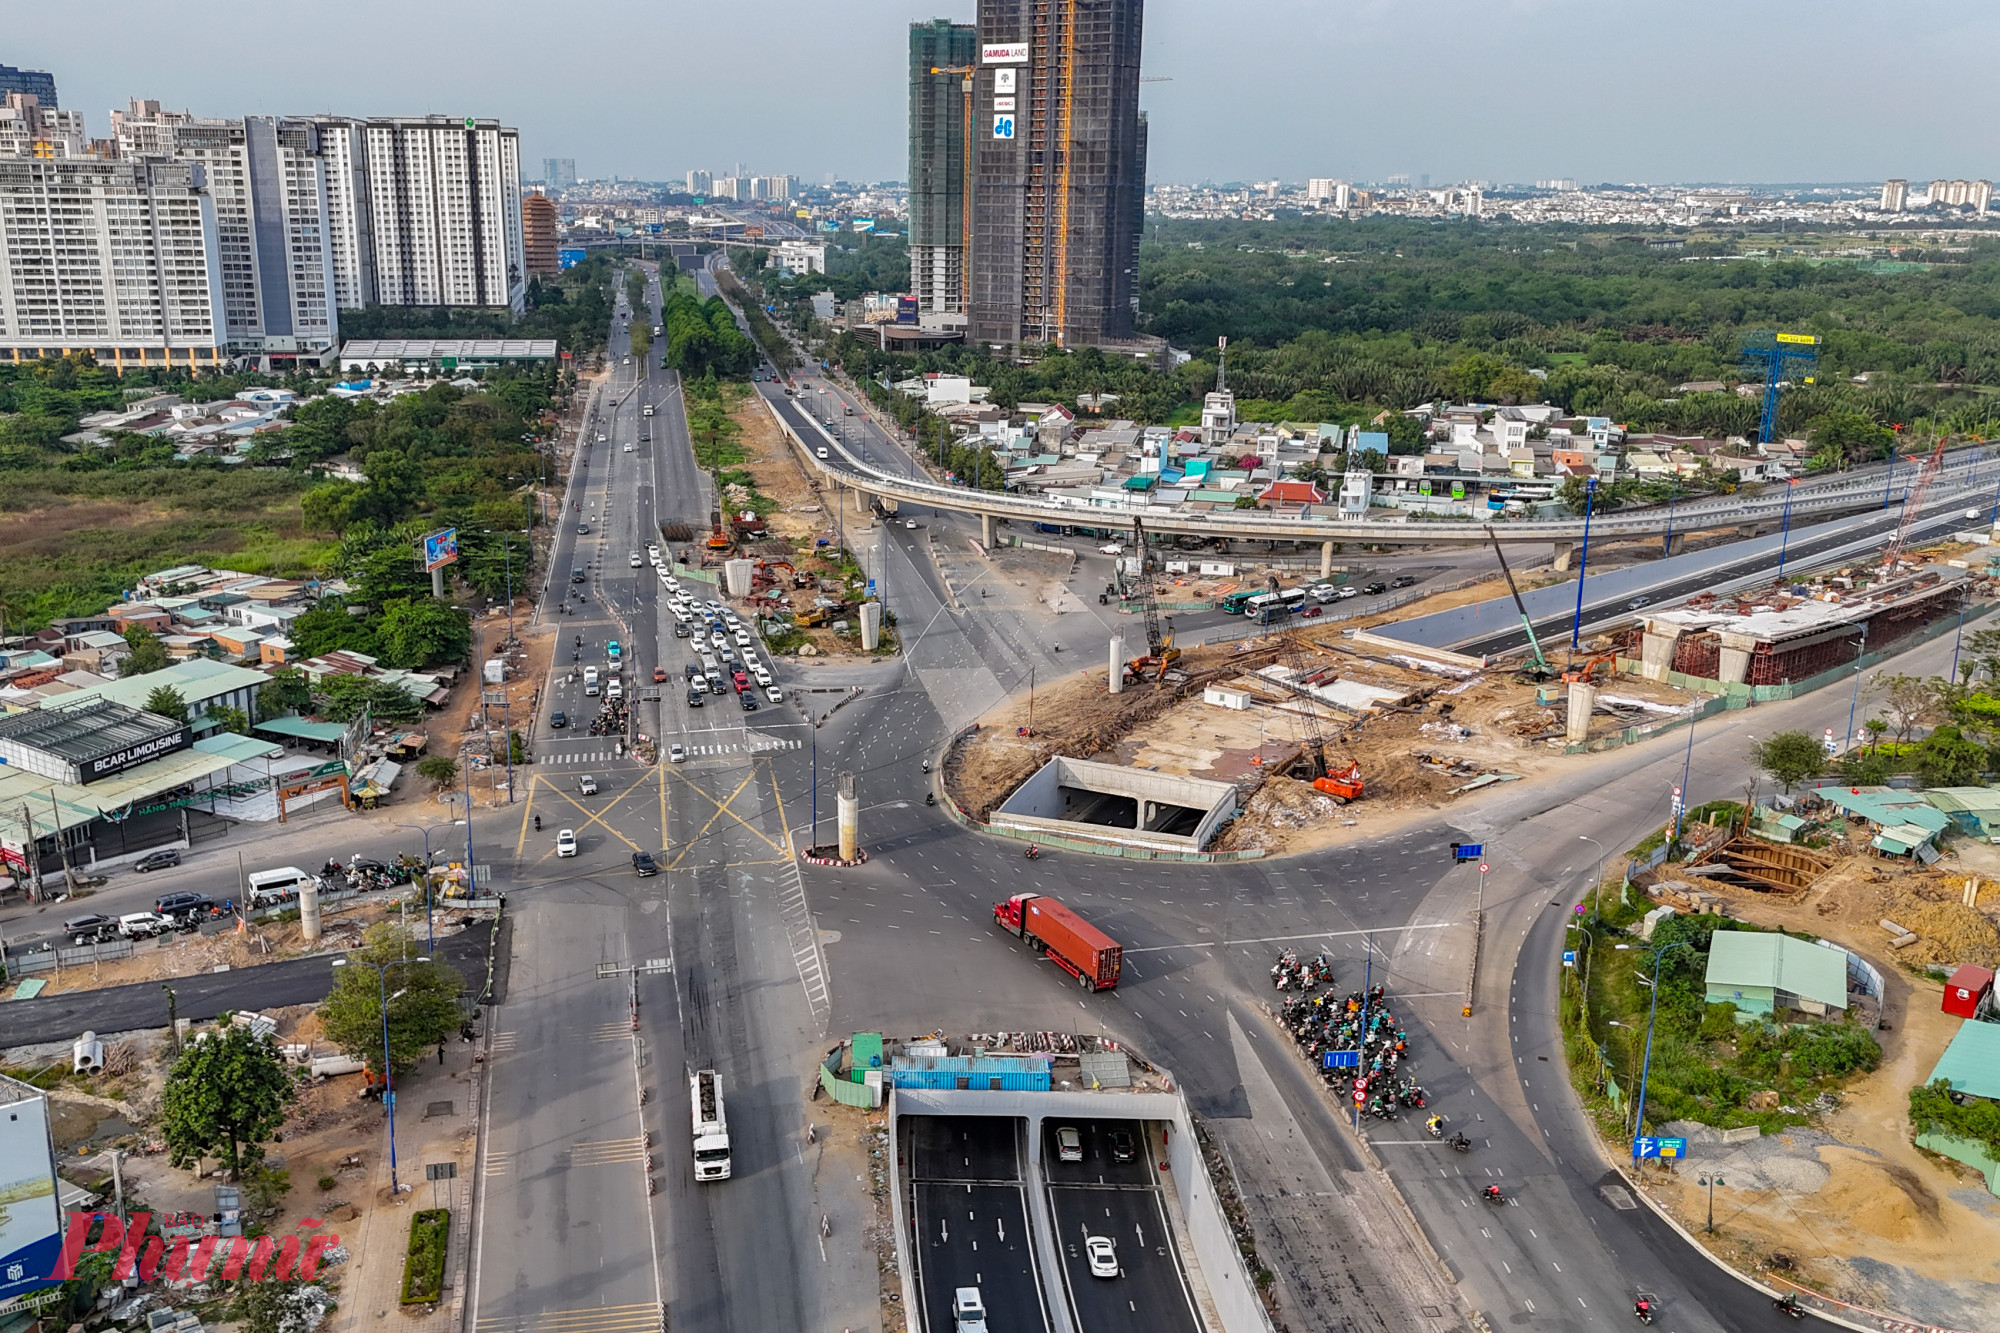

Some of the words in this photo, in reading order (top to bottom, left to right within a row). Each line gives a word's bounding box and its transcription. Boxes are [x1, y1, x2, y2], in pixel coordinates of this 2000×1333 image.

[984, 49, 1010, 58] GAMUDA
[1011, 48, 1027, 57] LAND
[93, 752, 126, 772] BCAR
[127, 732, 182, 760] LIMOUSINE
